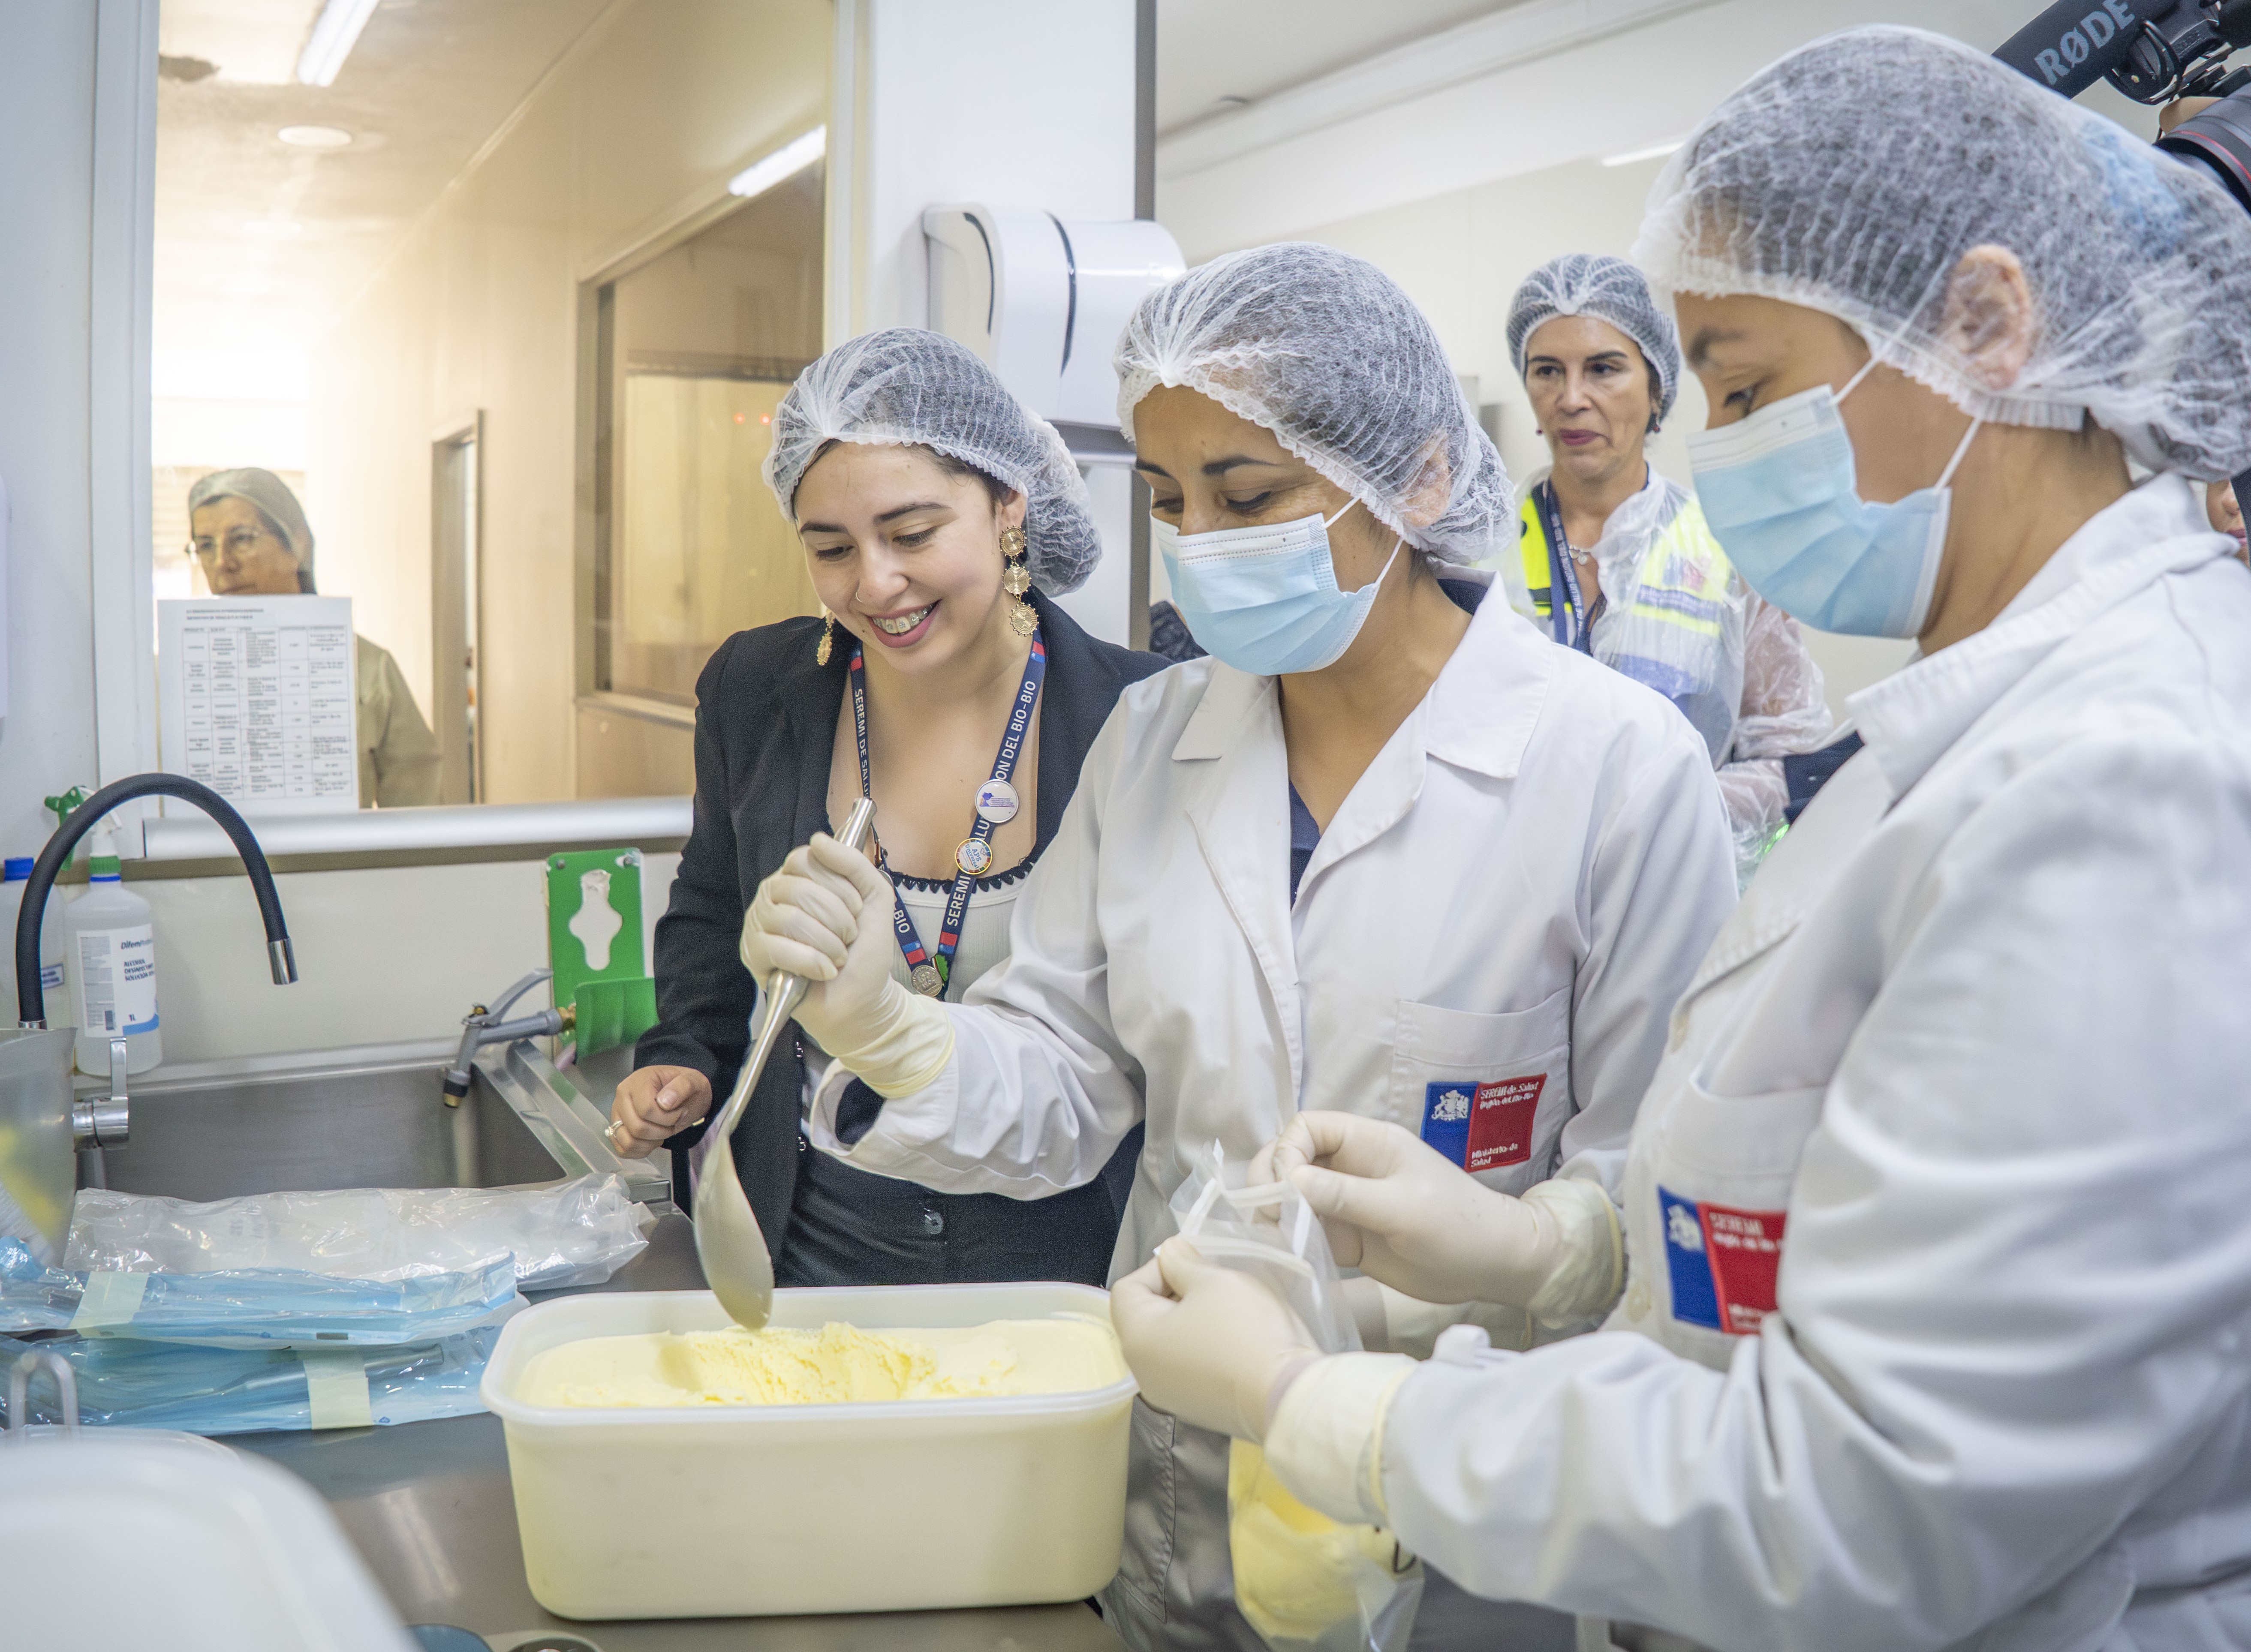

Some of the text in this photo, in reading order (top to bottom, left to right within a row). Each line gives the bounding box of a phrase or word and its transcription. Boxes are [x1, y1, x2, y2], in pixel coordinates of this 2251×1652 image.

[2034, 0, 2135, 85] RØDE
[855, 688, 865, 737] SEREMI
[860, 739, 867, 758] DE
[1002, 735, 1020, 759] DEL
[1011, 681, 1036, 732] BIO-BIO
[972, 849, 981, 862] APS
[894, 909, 910, 933] BIO
[947, 875, 972, 927] SEREMI
